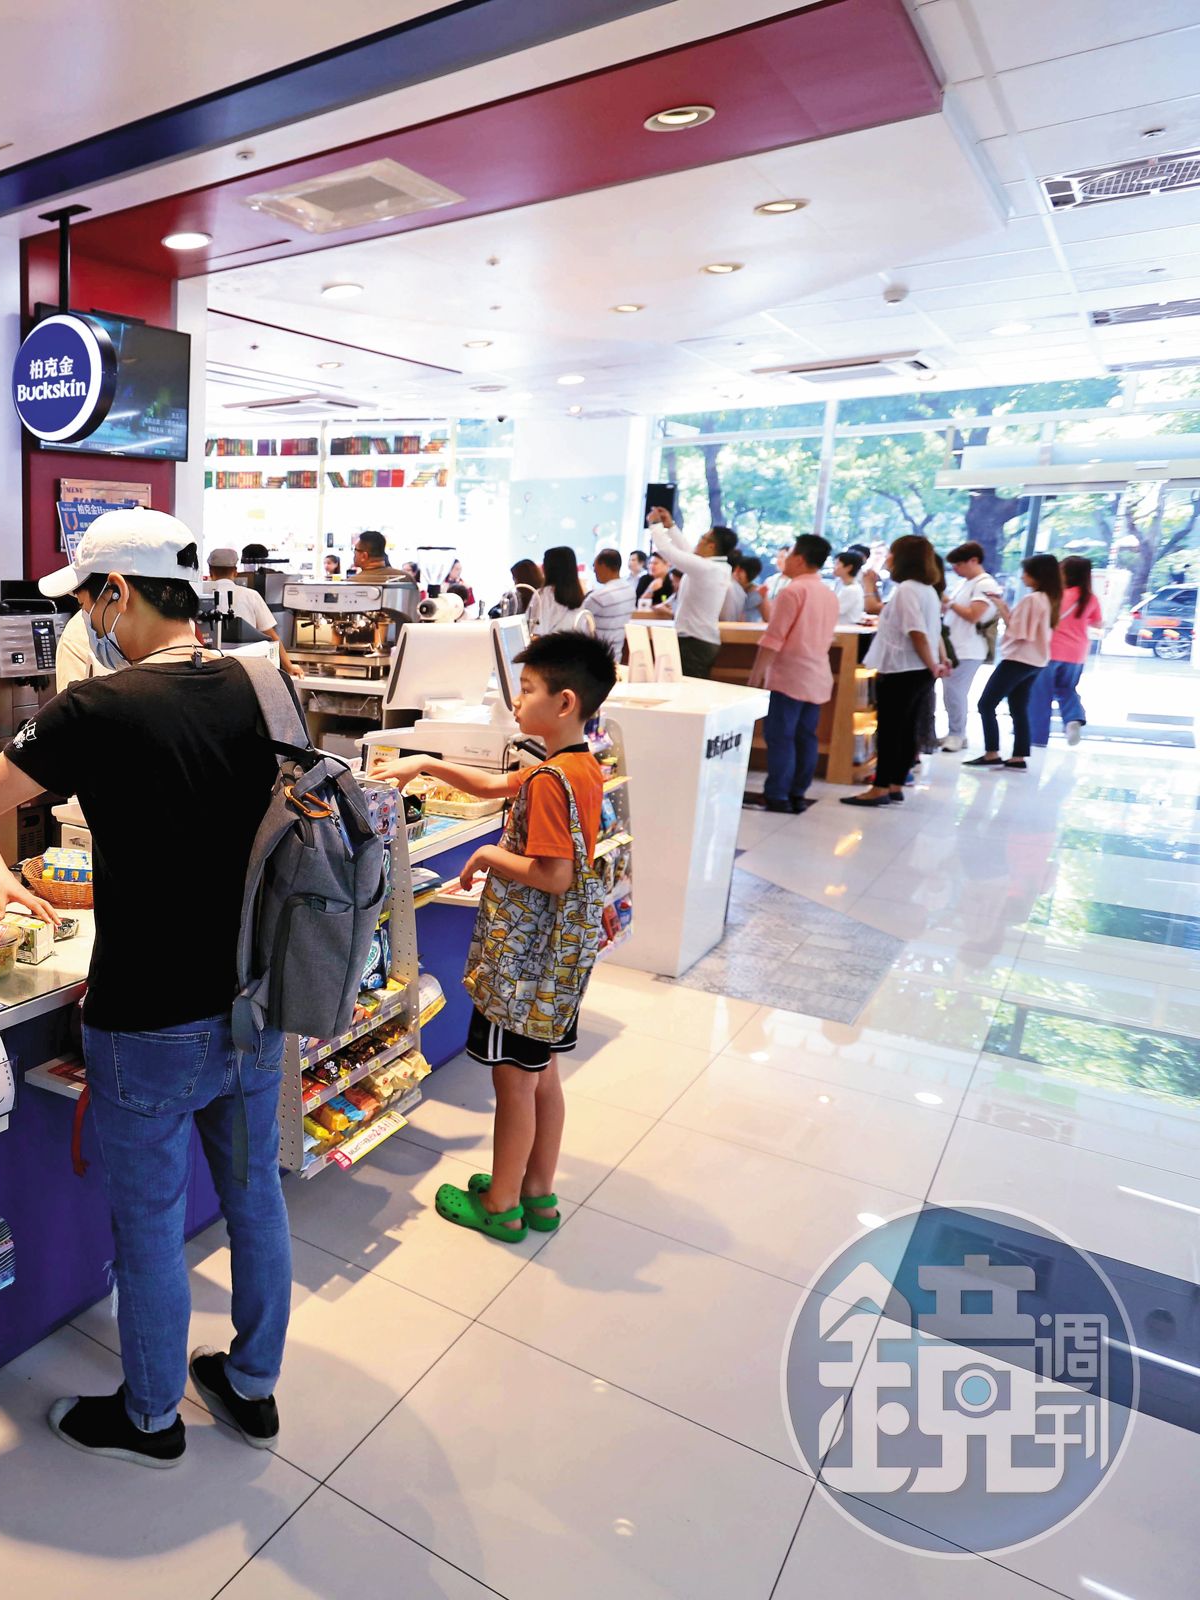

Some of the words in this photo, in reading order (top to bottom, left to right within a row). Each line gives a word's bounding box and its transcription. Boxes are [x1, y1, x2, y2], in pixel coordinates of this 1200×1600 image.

[29, 355, 74, 380] 柏克金
[17, 379, 87, 402] Buckskin
